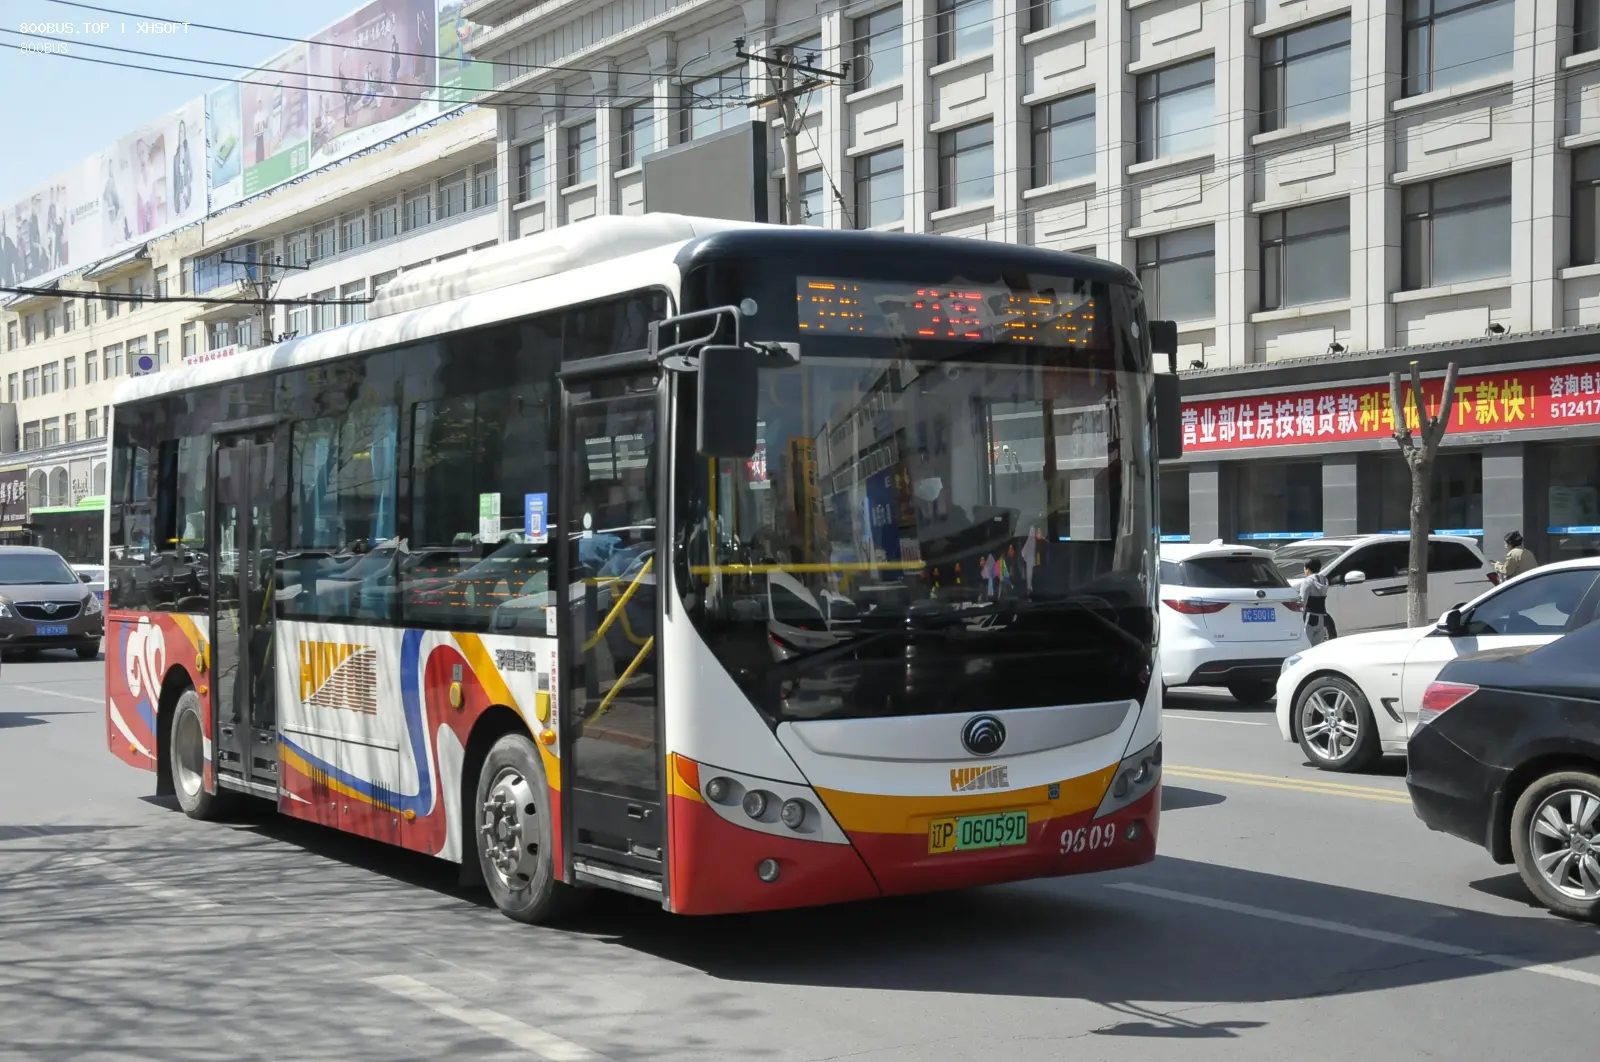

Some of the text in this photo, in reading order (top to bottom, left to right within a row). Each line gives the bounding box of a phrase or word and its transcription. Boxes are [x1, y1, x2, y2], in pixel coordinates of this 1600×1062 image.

[1550, 399, 1600, 419] 512417
[949, 764, 1010, 792] HUYUE
[961, 814, 1027, 846] 06059D
[1060, 822, 1117, 855] 9609
